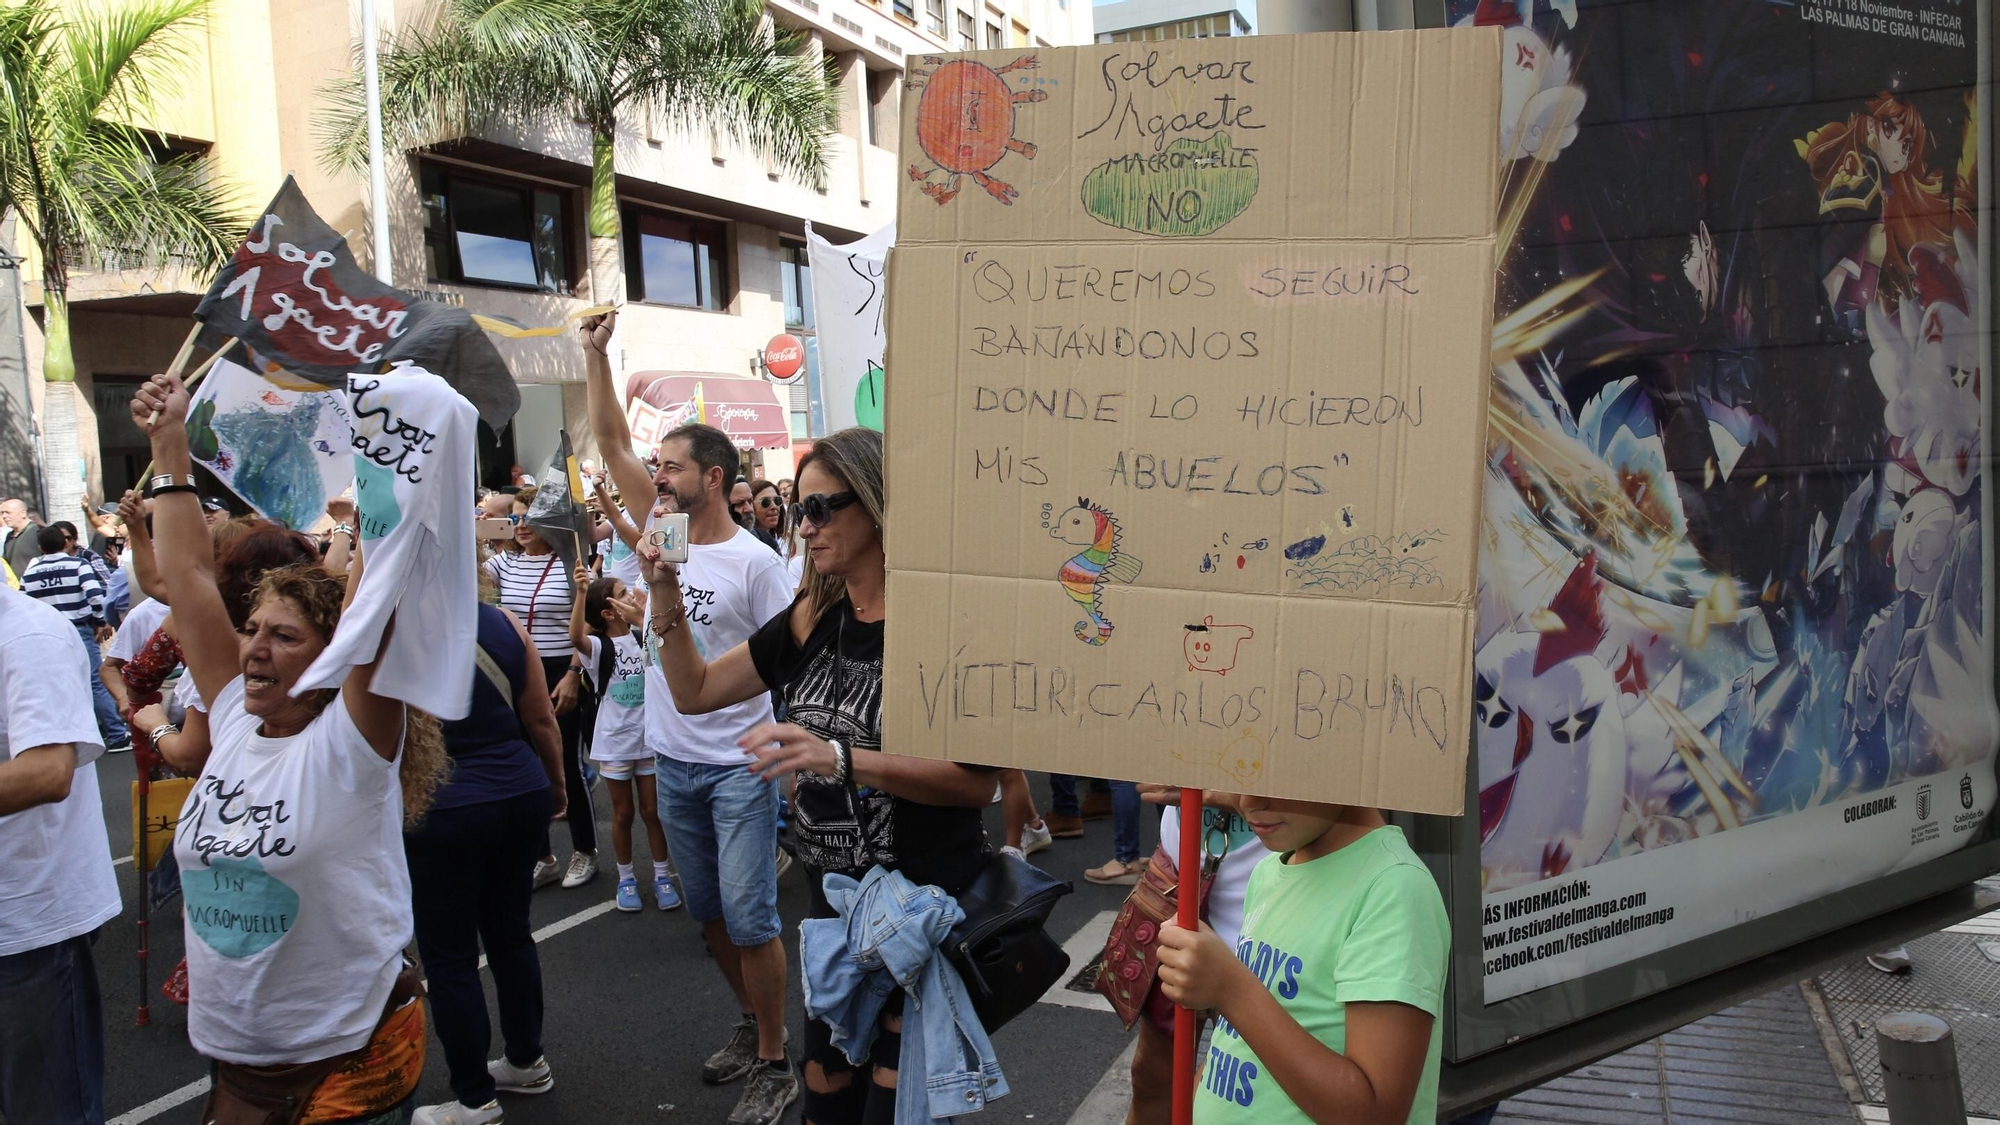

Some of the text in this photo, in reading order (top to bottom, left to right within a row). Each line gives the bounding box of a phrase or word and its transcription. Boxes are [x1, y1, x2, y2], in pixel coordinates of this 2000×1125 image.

[1800, 5, 1966, 48] LAS PALMAS DE GRAN CANARIA
[1860, 0, 1913, 21] Noviembre
[1919, 9, 1962, 30] INFECAR
[1105, 149, 1259, 175] MACROMUELLE
[1147, 190, 1202, 230] NO
[970, 323, 1259, 361] BAÑÁNDONOS
[972, 385, 1126, 423] DONDE
[1150, 394, 1198, 421] LO
[1294, 668, 1447, 755] BRUNO
[1844, 795, 1897, 823] COLABORAN:
[1955, 809, 1984, 823] Cabildo de
[824, 835, 853, 847] HALL
[1953, 824, 1968, 833] Gran
[1504, 880, 1591, 920] INFORMACIÓN:
[1483, 907, 1674, 976] cebook.com/festivaldelmanga
[1206, 1045, 1258, 1107] THIS
